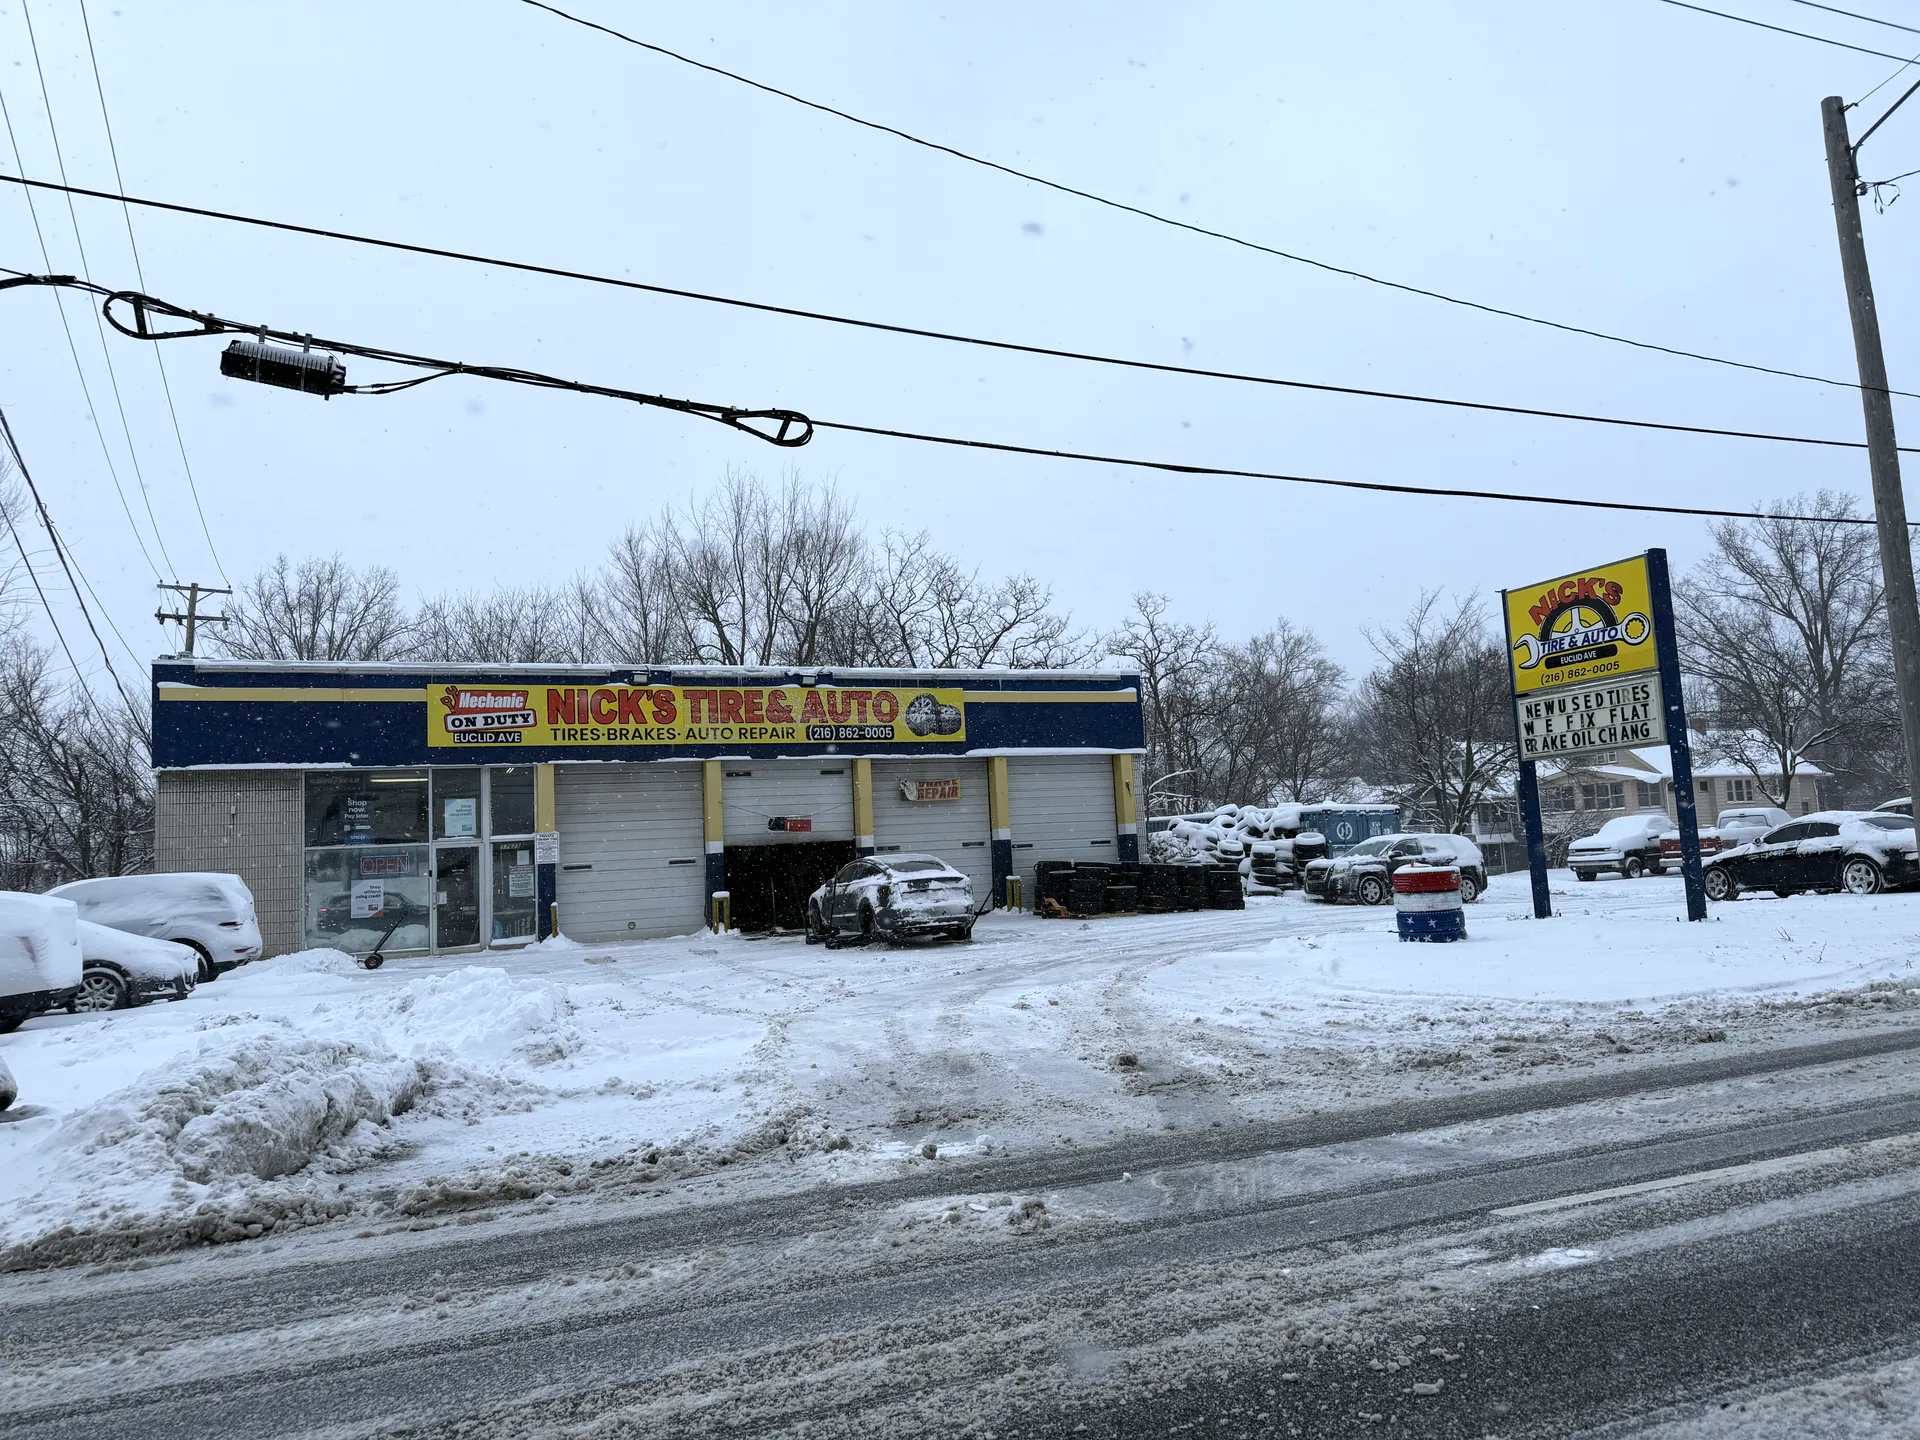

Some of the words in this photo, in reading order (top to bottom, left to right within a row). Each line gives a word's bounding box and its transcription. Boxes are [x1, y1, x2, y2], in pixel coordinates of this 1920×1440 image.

[1528, 577, 1623, 626] NICK'S
[1541, 636, 1565, 654] TIRE
[1568, 635, 1578, 648] &
[1581, 627, 1618, 646] AUTO
[1560, 653, 1583, 664] EUCLID
[1583, 650, 1597, 661] AVE
[1540, 670, 1564, 685] (216)
[1567, 661, 1620, 679] 862-0005
[458, 692, 524, 708] Mechanic
[547, 689, 677, 725] NICK'S
[800, 689, 900, 724] AUTO
[451, 716, 477, 728] ON
[482, 713, 532, 726] DUTY
[1566, 712, 1595, 730] FIX
[1609, 703, 1650, 724] FLAT
[454, 733, 495, 743] EUCLID
[498, 732, 521, 743] AVE
[685, 727, 733, 740] AUTO
[738, 727, 795, 740] REPAIR
[808, 725, 836, 741] (216)
[838, 727, 893, 739] 862-0005
[1572, 731, 1595, 747] OIL
[1598, 722, 1650, 743] CHANG
[917, 786, 959, 800] REPAIR
[362, 857, 408, 873] OPEN
